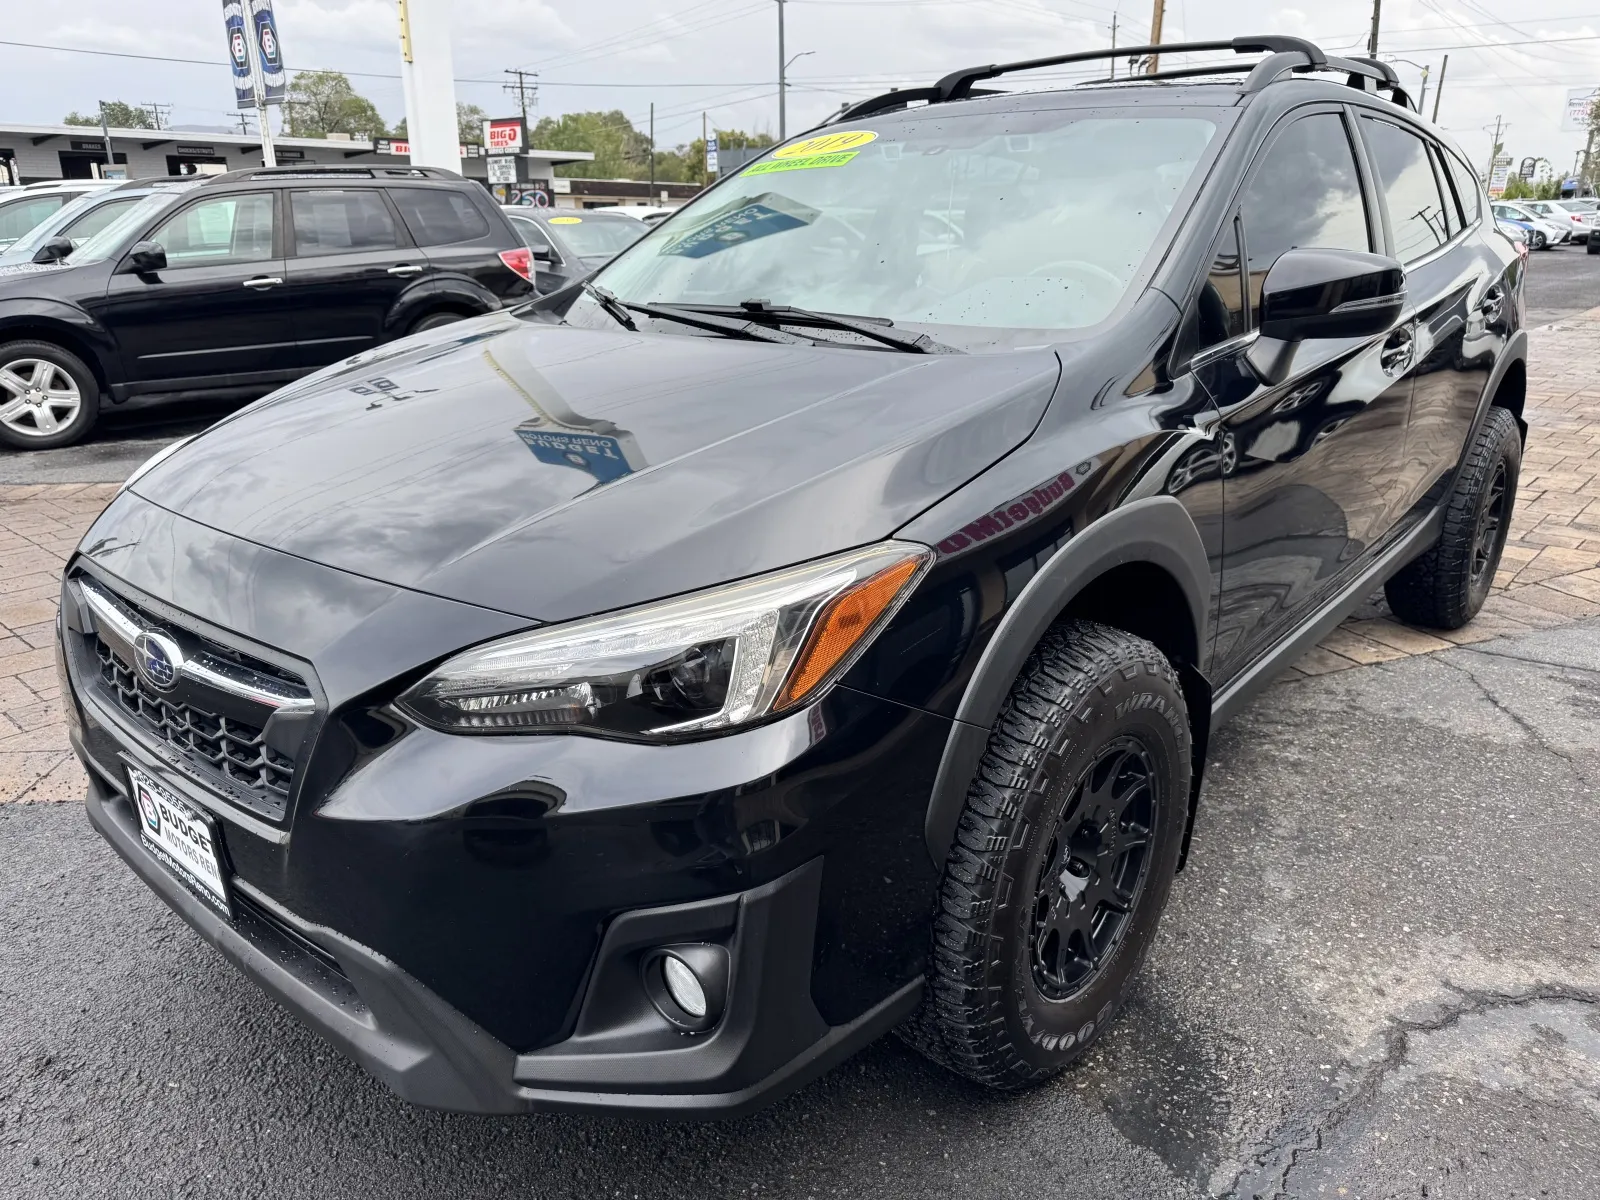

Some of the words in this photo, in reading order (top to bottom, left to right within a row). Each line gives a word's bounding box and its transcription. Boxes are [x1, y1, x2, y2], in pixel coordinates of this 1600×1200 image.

[490, 130, 506, 140] BIG
[808, 153, 854, 165] DRIVE
[164, 826, 200, 862] MOTORS
[199, 854, 220, 881] REN
